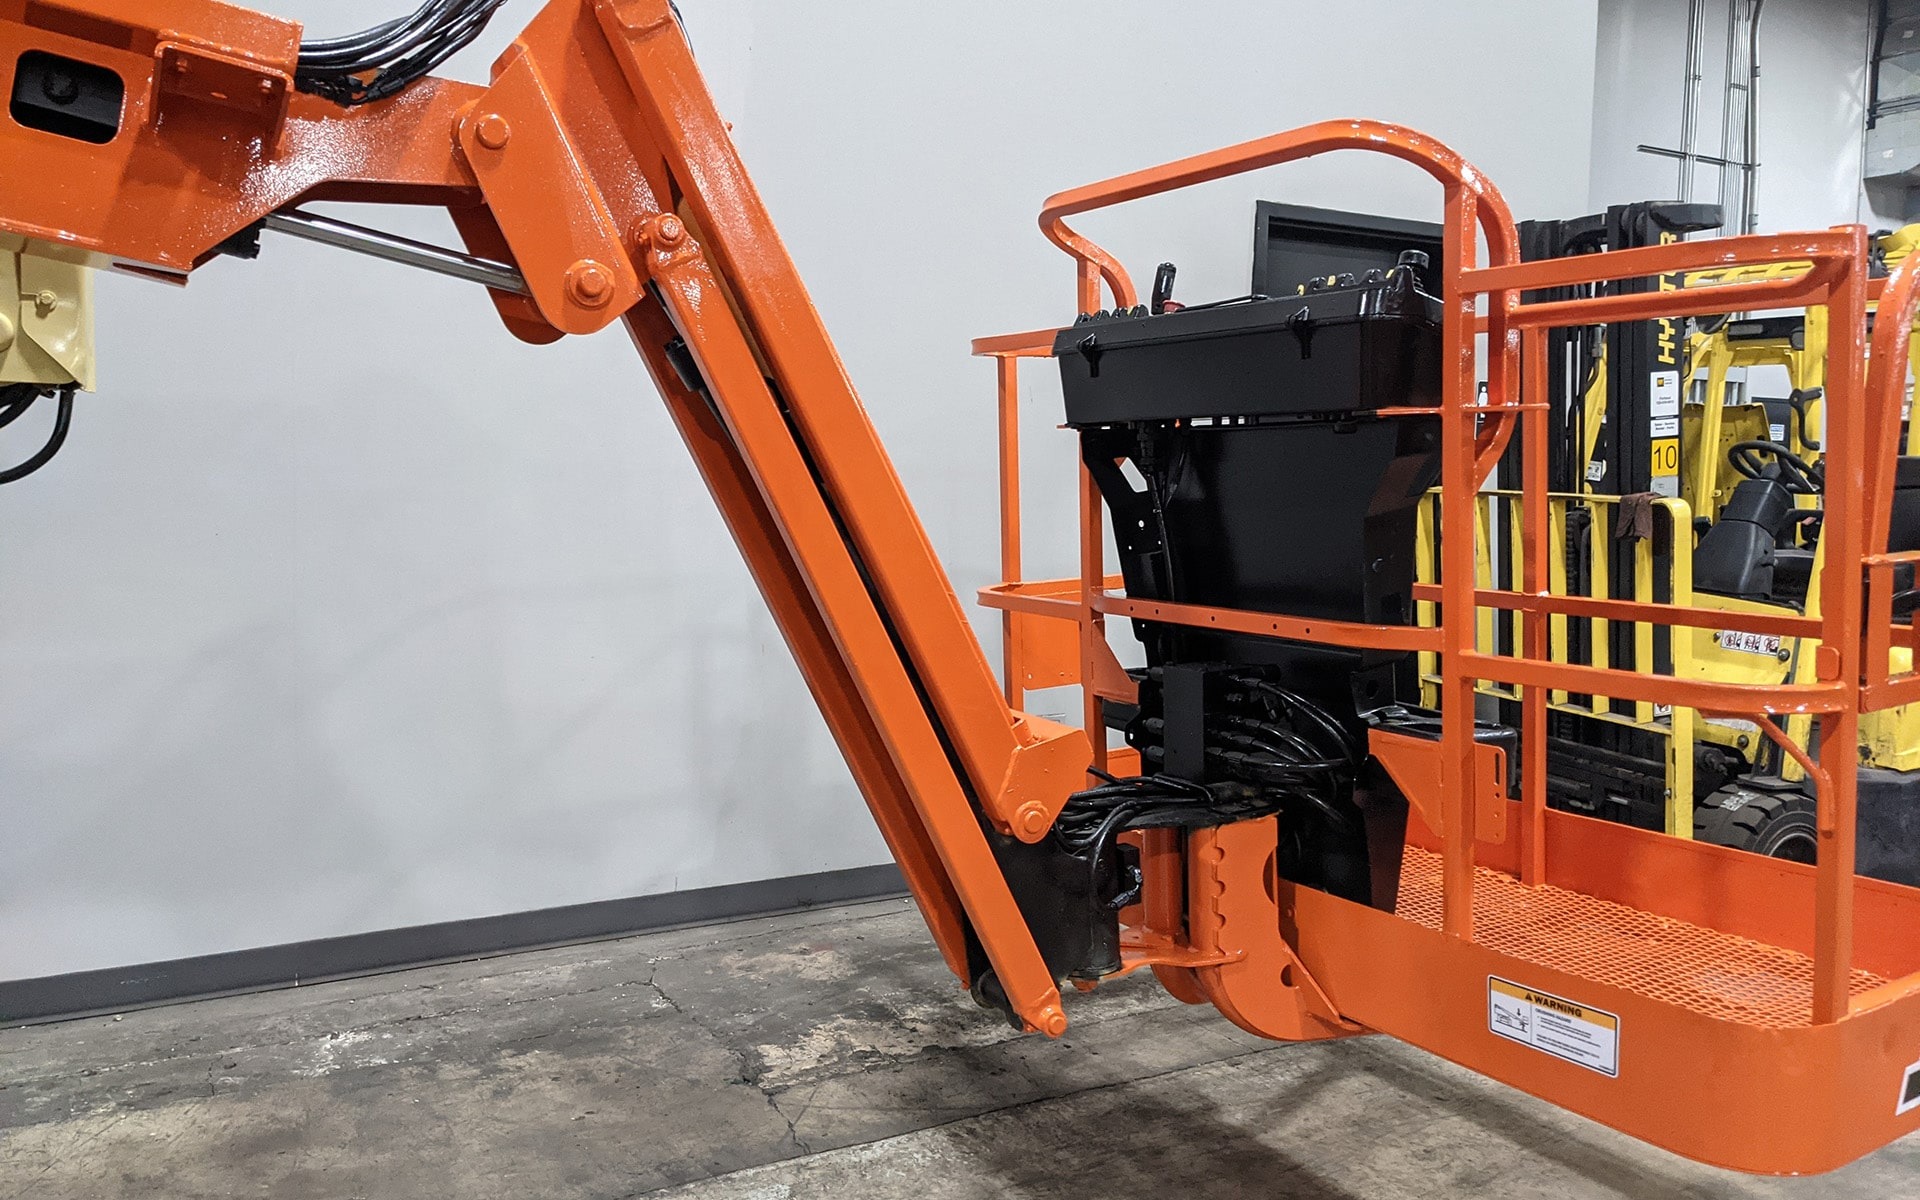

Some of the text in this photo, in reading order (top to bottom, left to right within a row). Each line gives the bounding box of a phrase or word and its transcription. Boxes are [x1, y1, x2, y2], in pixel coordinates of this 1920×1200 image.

[1658, 231, 1677, 364] HYTR
[1654, 445, 1677, 469] 10
[1534, 995, 1582, 1017] WARNING
